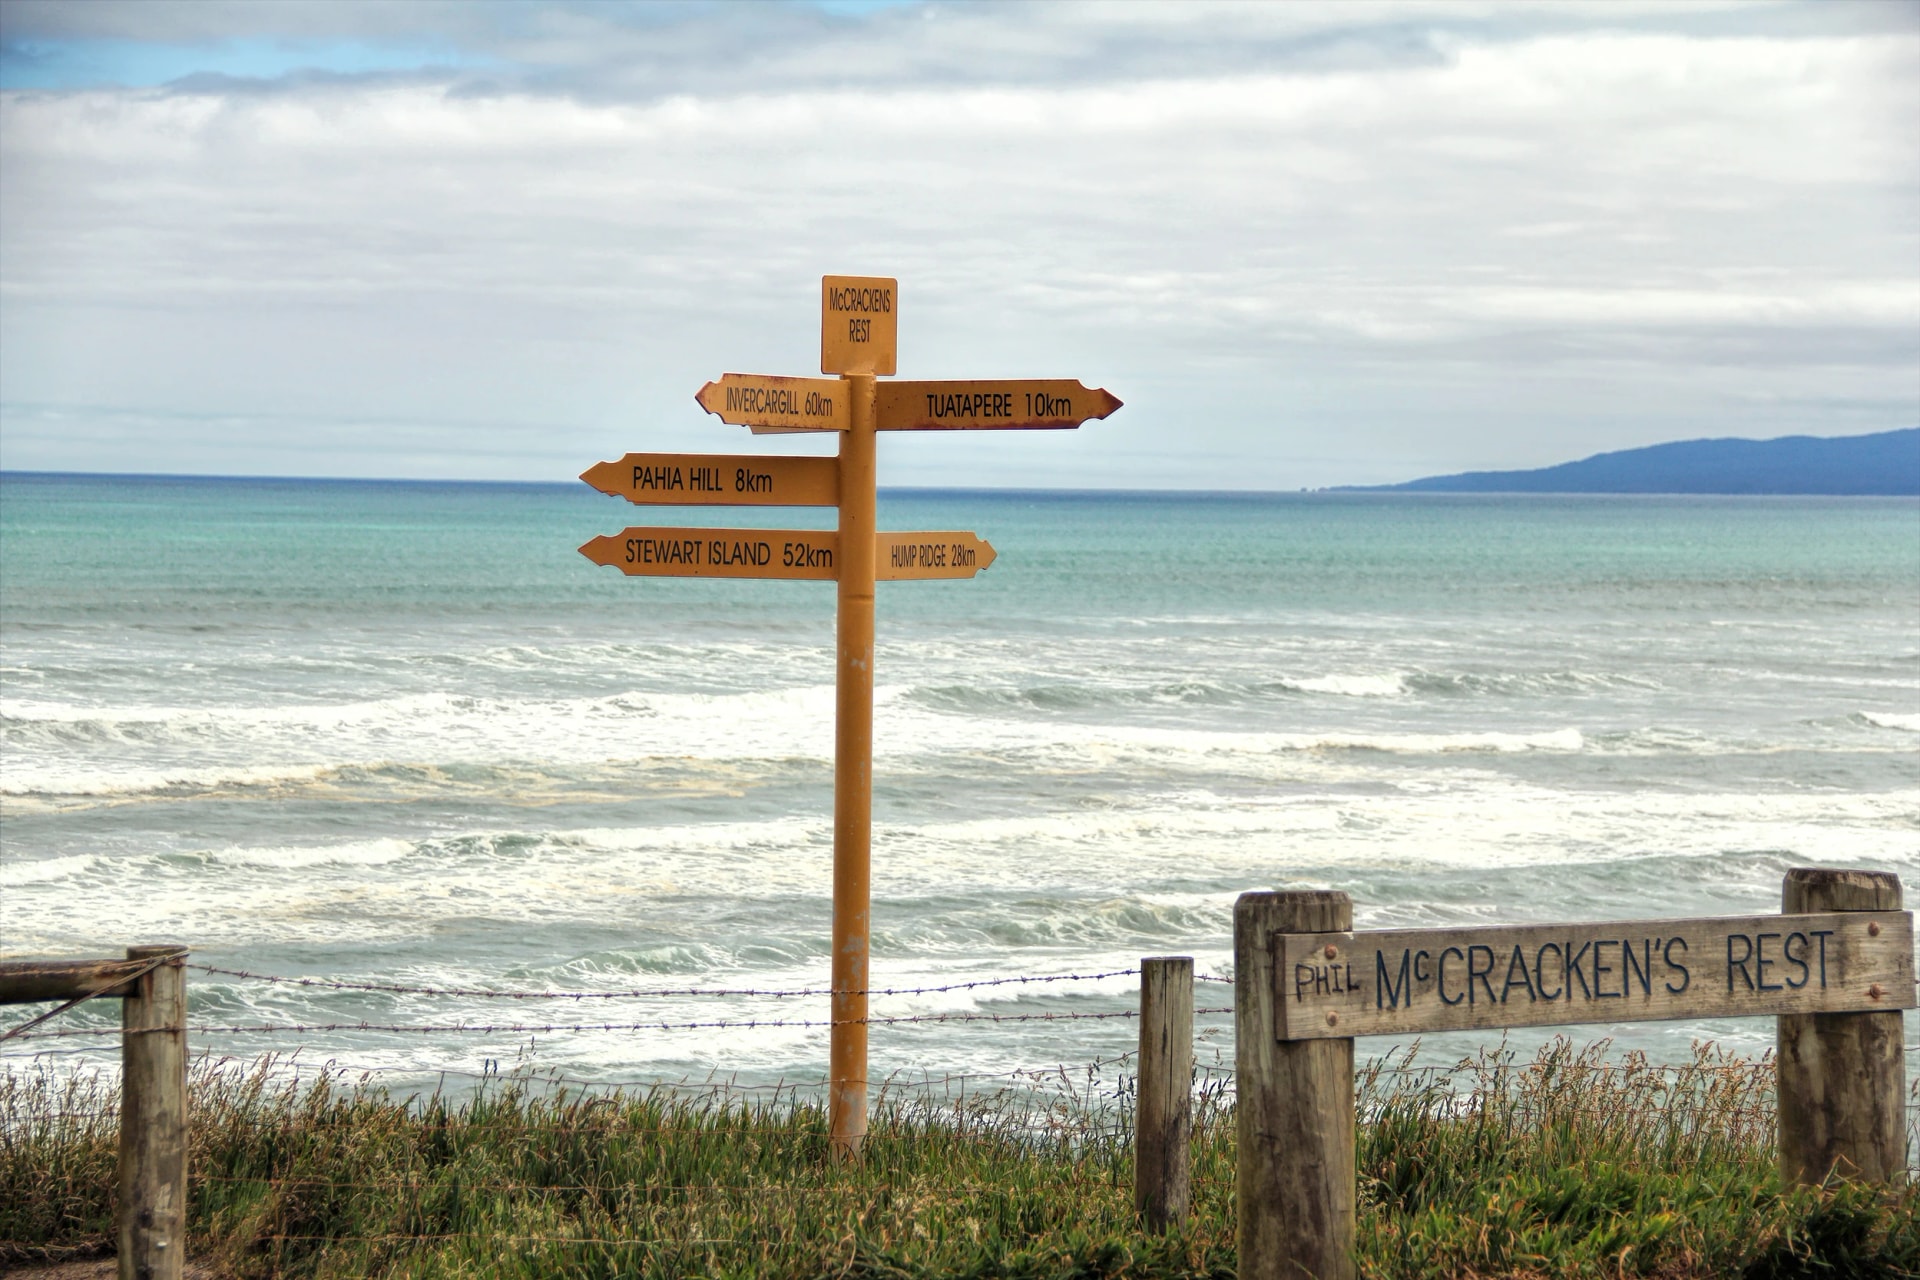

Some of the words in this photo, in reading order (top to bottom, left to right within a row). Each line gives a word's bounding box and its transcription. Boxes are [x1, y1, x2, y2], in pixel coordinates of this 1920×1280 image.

[829, 287, 891, 313] McCRACKENS
[849, 319, 871, 343] REST
[726, 387, 799, 414] INVERCARGILL
[804, 392, 833, 417] 60km
[927, 393, 1012, 417] TUATAPERE
[1025, 393, 1072, 417] 10km
[633, 466, 684, 490] PAHIA
[690, 468, 723, 491] HILL
[735, 468, 772, 493] 8km
[625, 539, 702, 564] STEWART
[708, 541, 771, 566] ISLAND
[783, 543, 833, 568] 52km
[891, 545, 917, 568] HUMP
[919, 544, 946, 567] RIDGE
[951, 544, 976, 567] 28km
[1295, 962, 1361, 1003] PHIL
[1726, 930, 1834, 992] REST
